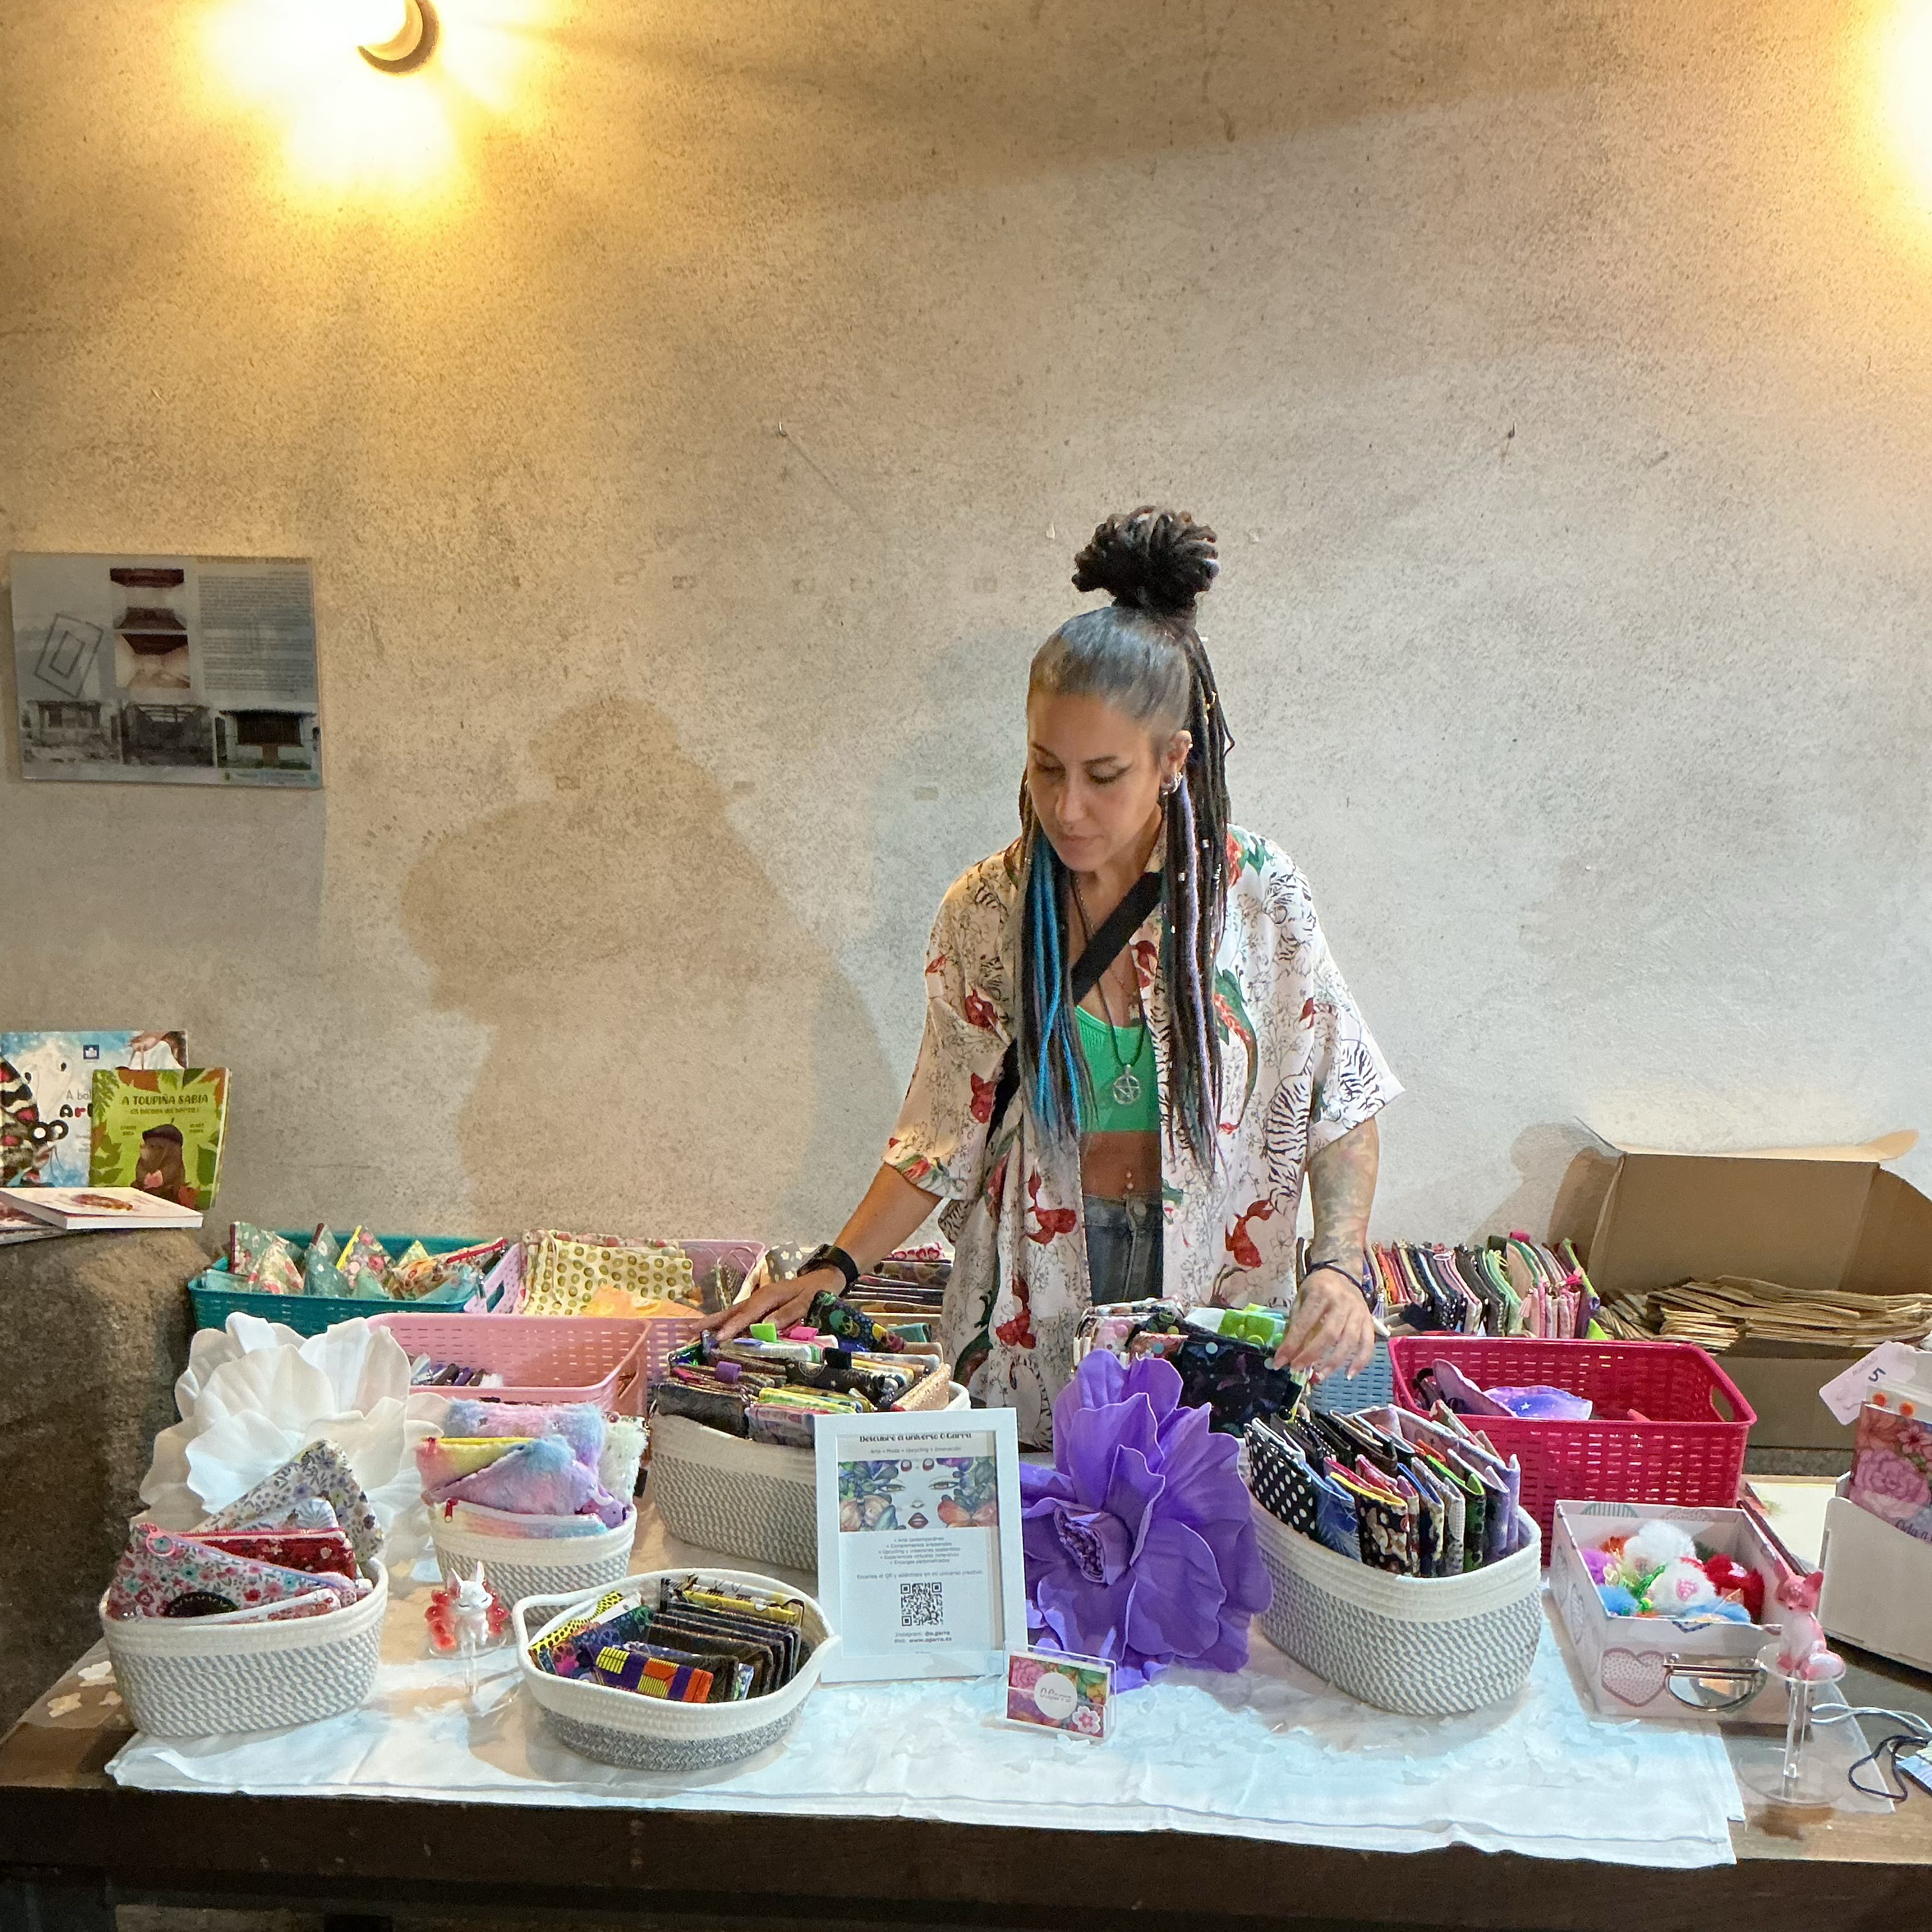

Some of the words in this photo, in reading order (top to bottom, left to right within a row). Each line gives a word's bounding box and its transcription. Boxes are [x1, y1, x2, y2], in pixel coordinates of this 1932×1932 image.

[66, 1089, 73, 1100] A
[121, 1096, 130, 1106] A
[178, 1094, 208, 1105] SABIA
[1868, 1367, 1887, 1382] 5
